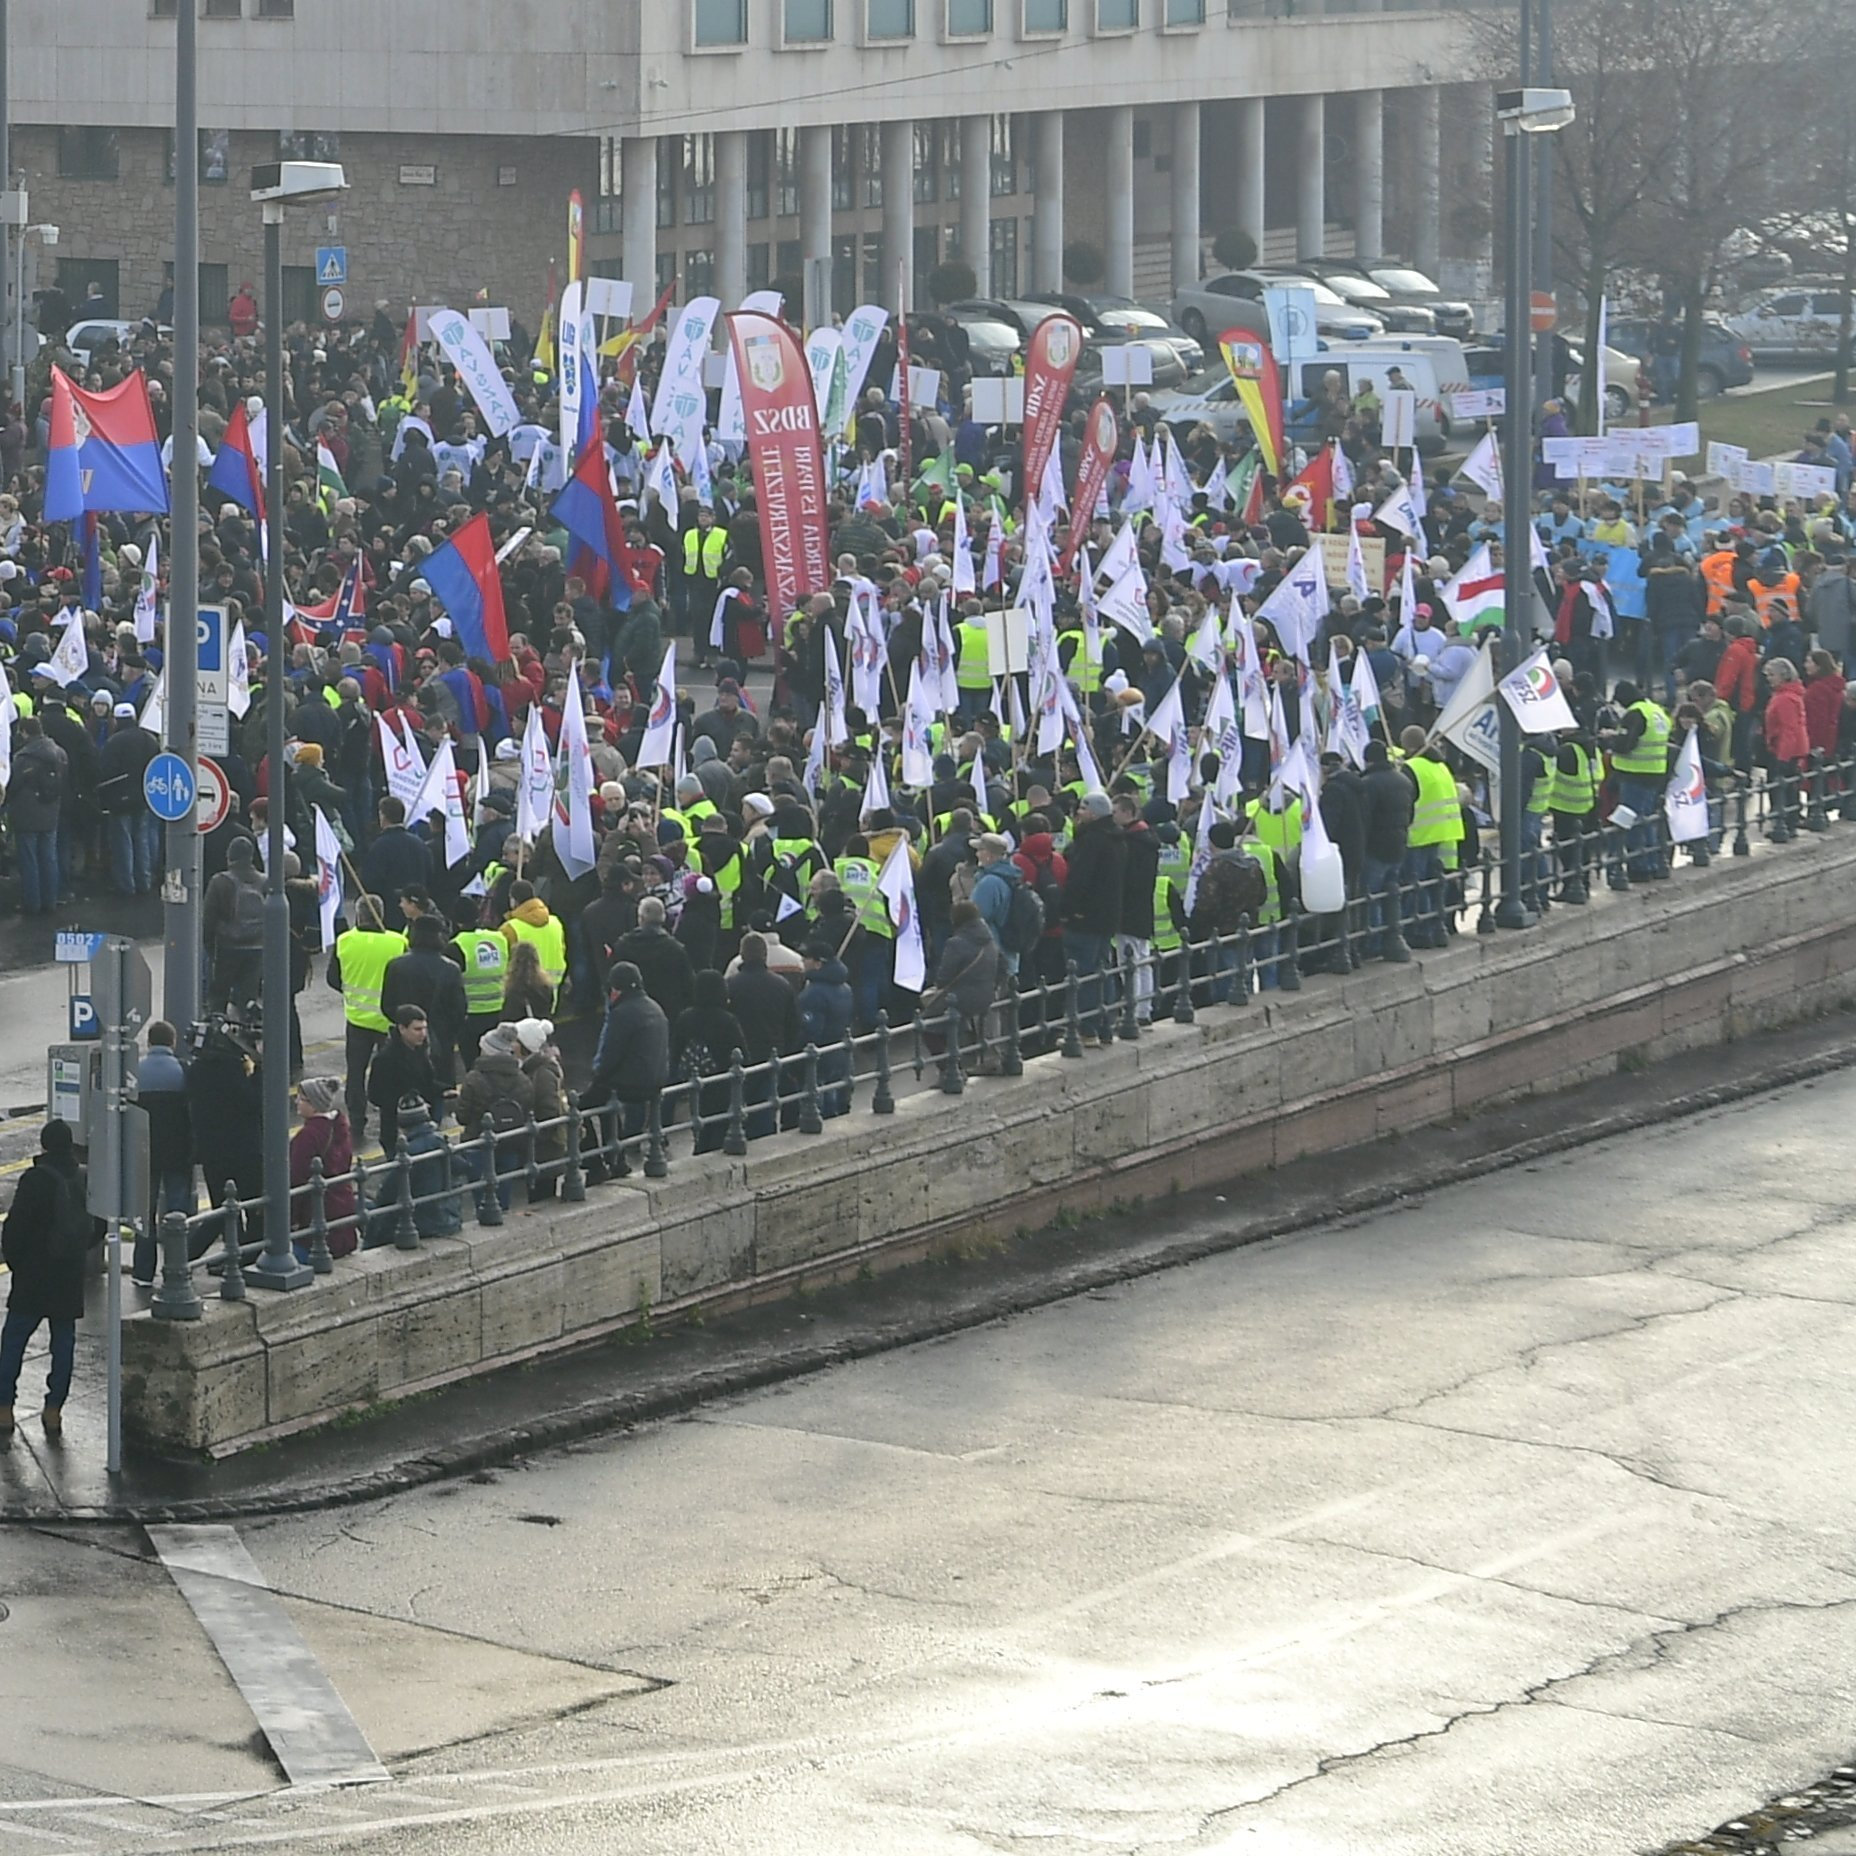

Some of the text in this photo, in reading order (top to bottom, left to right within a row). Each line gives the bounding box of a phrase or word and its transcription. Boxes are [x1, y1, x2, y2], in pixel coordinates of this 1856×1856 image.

[1025, 373, 1048, 417] BDSZ
[197, 682, 217, 695] NA
[57, 932, 94, 946] 0502
[74, 1001, 93, 1029] P
